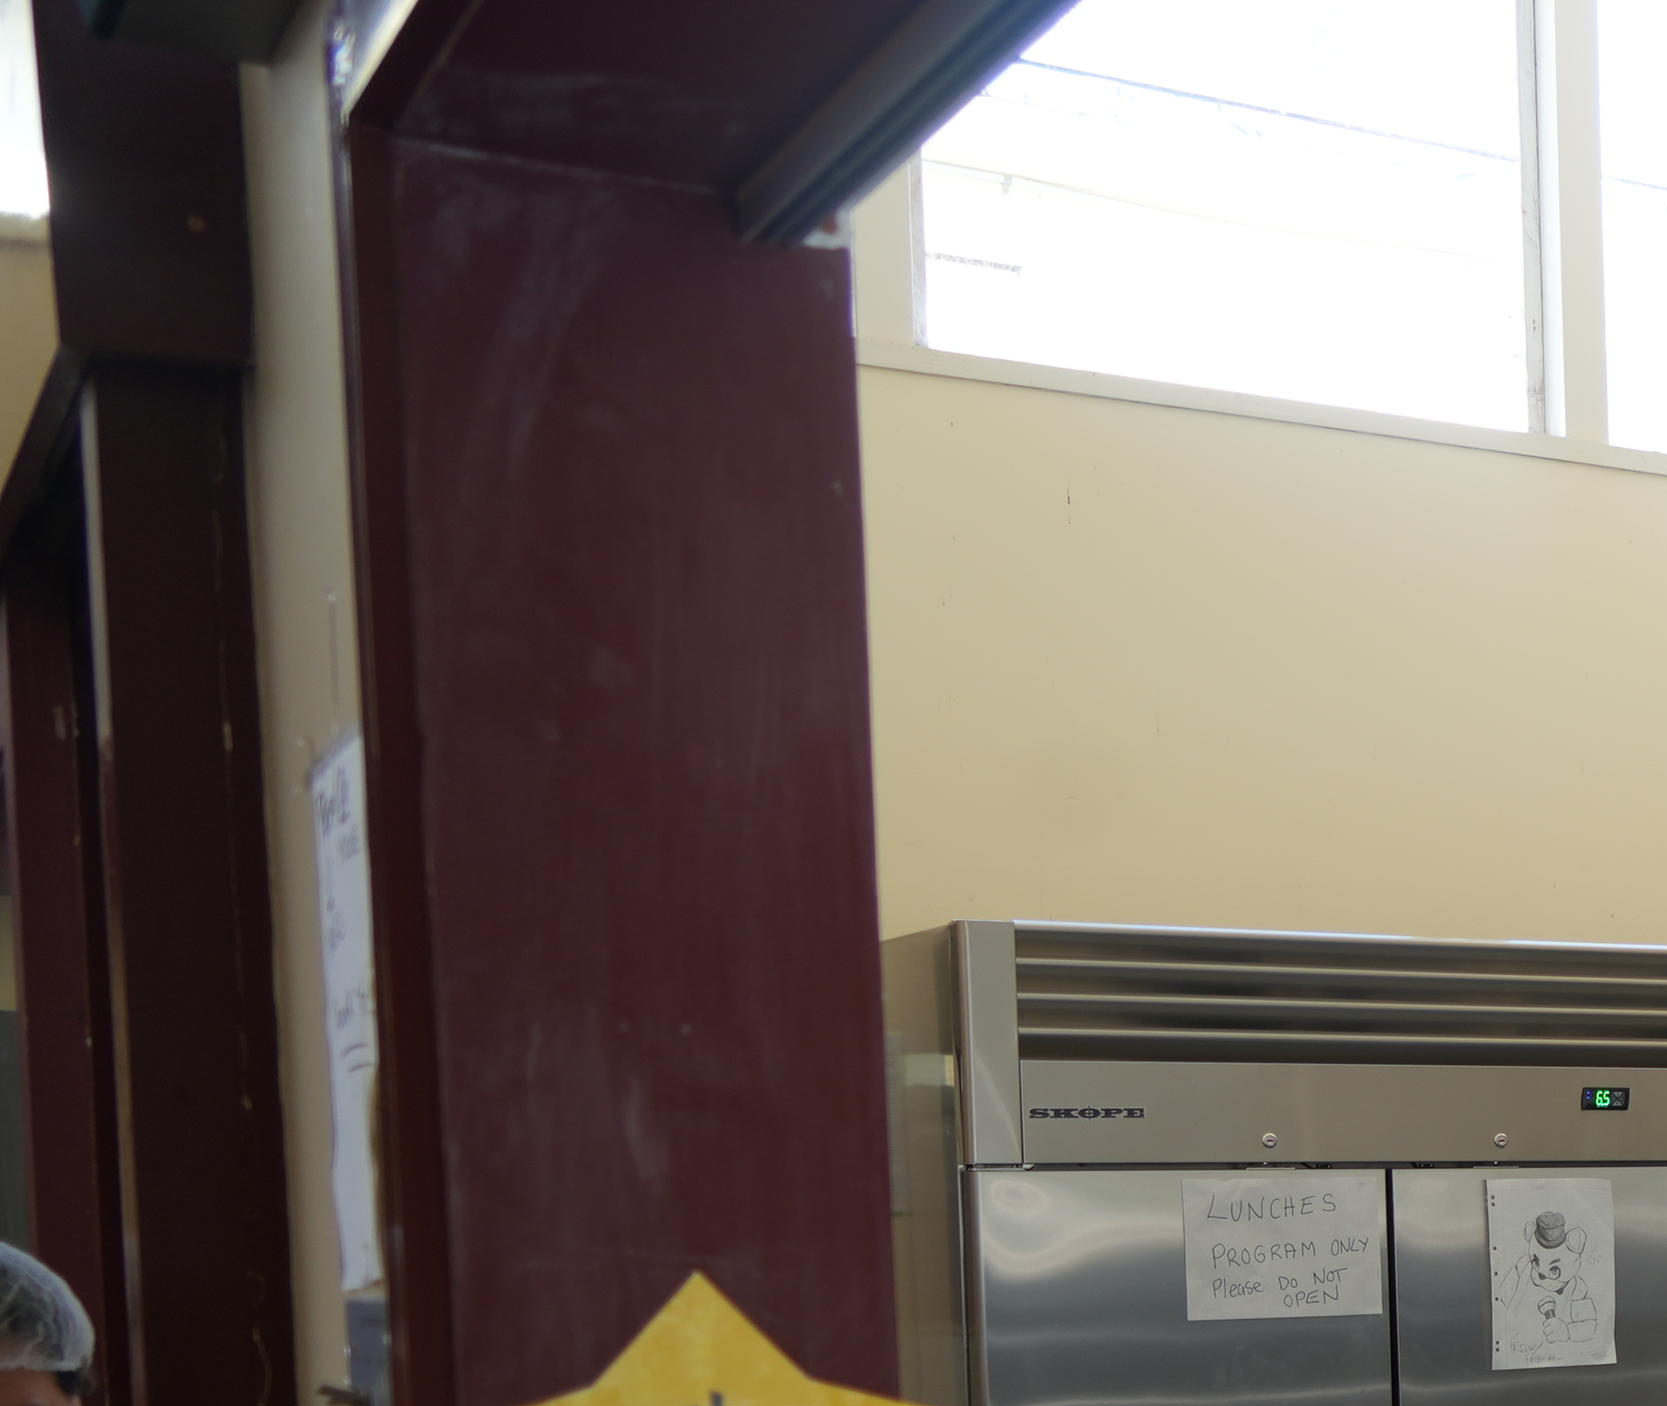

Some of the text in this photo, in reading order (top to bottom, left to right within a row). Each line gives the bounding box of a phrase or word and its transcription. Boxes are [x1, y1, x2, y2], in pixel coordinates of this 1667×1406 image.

[1029, 1107, 1145, 1120] SKOPE
[1207, 1193, 1336, 1222] LUNCHES
[1212, 1238, 1369, 1268] PROGRAM ONLY
[1212, 1278, 1264, 1299] Please
[1313, 1267, 1348, 1285] NOT
[1283, 1285, 1339, 1308] OPEN
